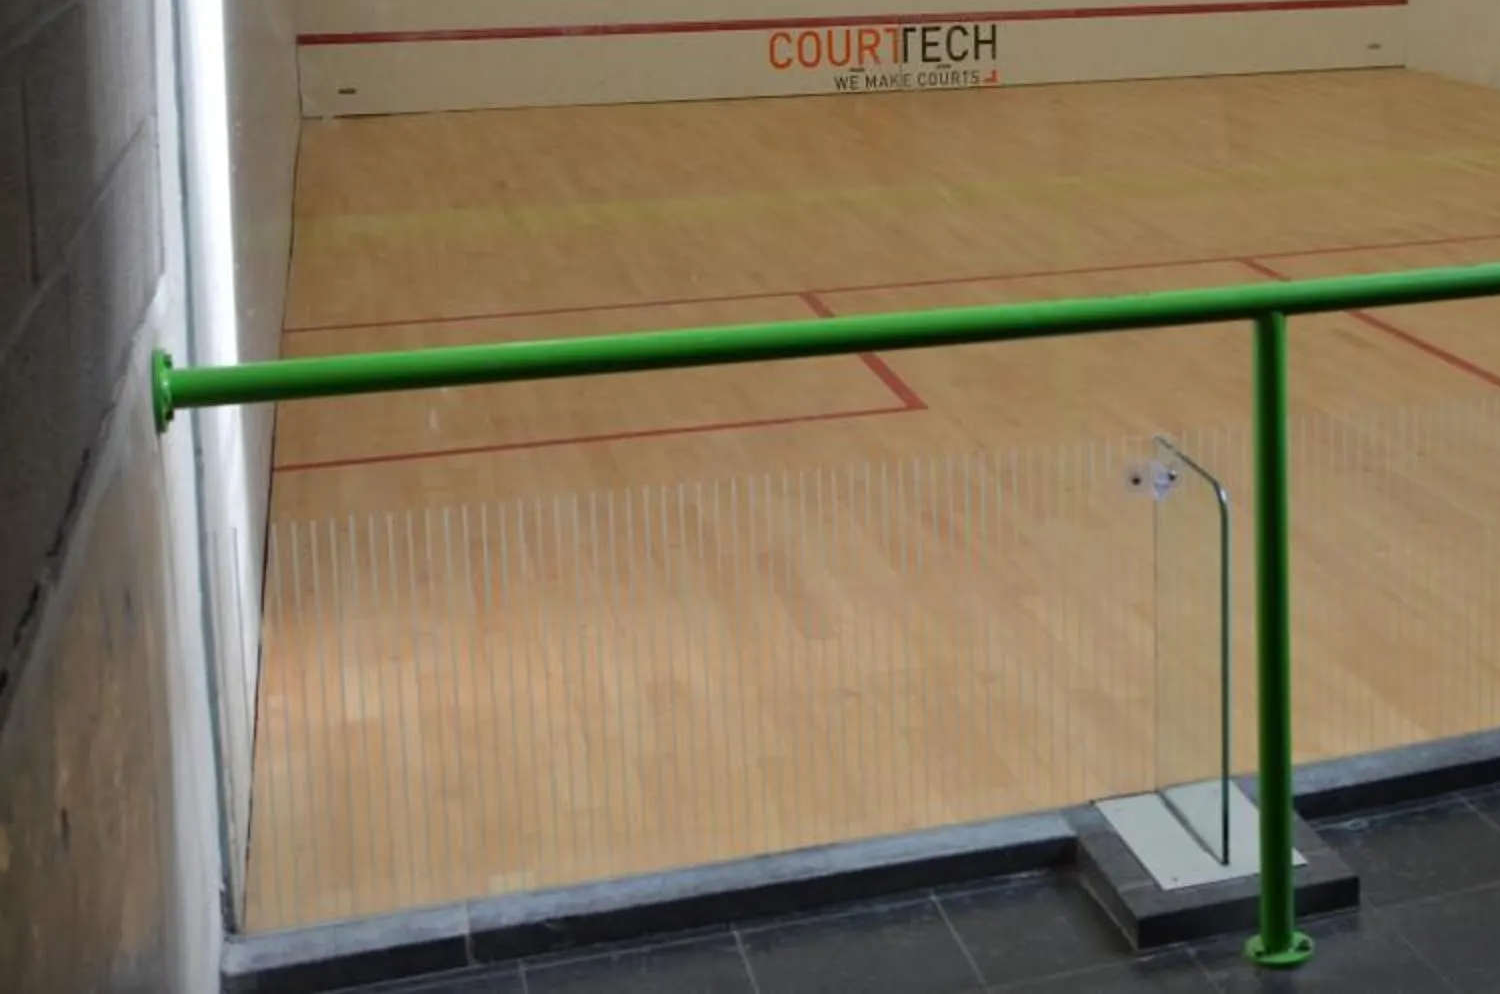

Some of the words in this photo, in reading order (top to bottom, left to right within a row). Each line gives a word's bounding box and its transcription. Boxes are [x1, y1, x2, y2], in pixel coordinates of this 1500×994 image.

[834, 75, 859, 90] WE
[865, 72, 912, 89] MAKE
[917, 69, 981, 87] COURTS
